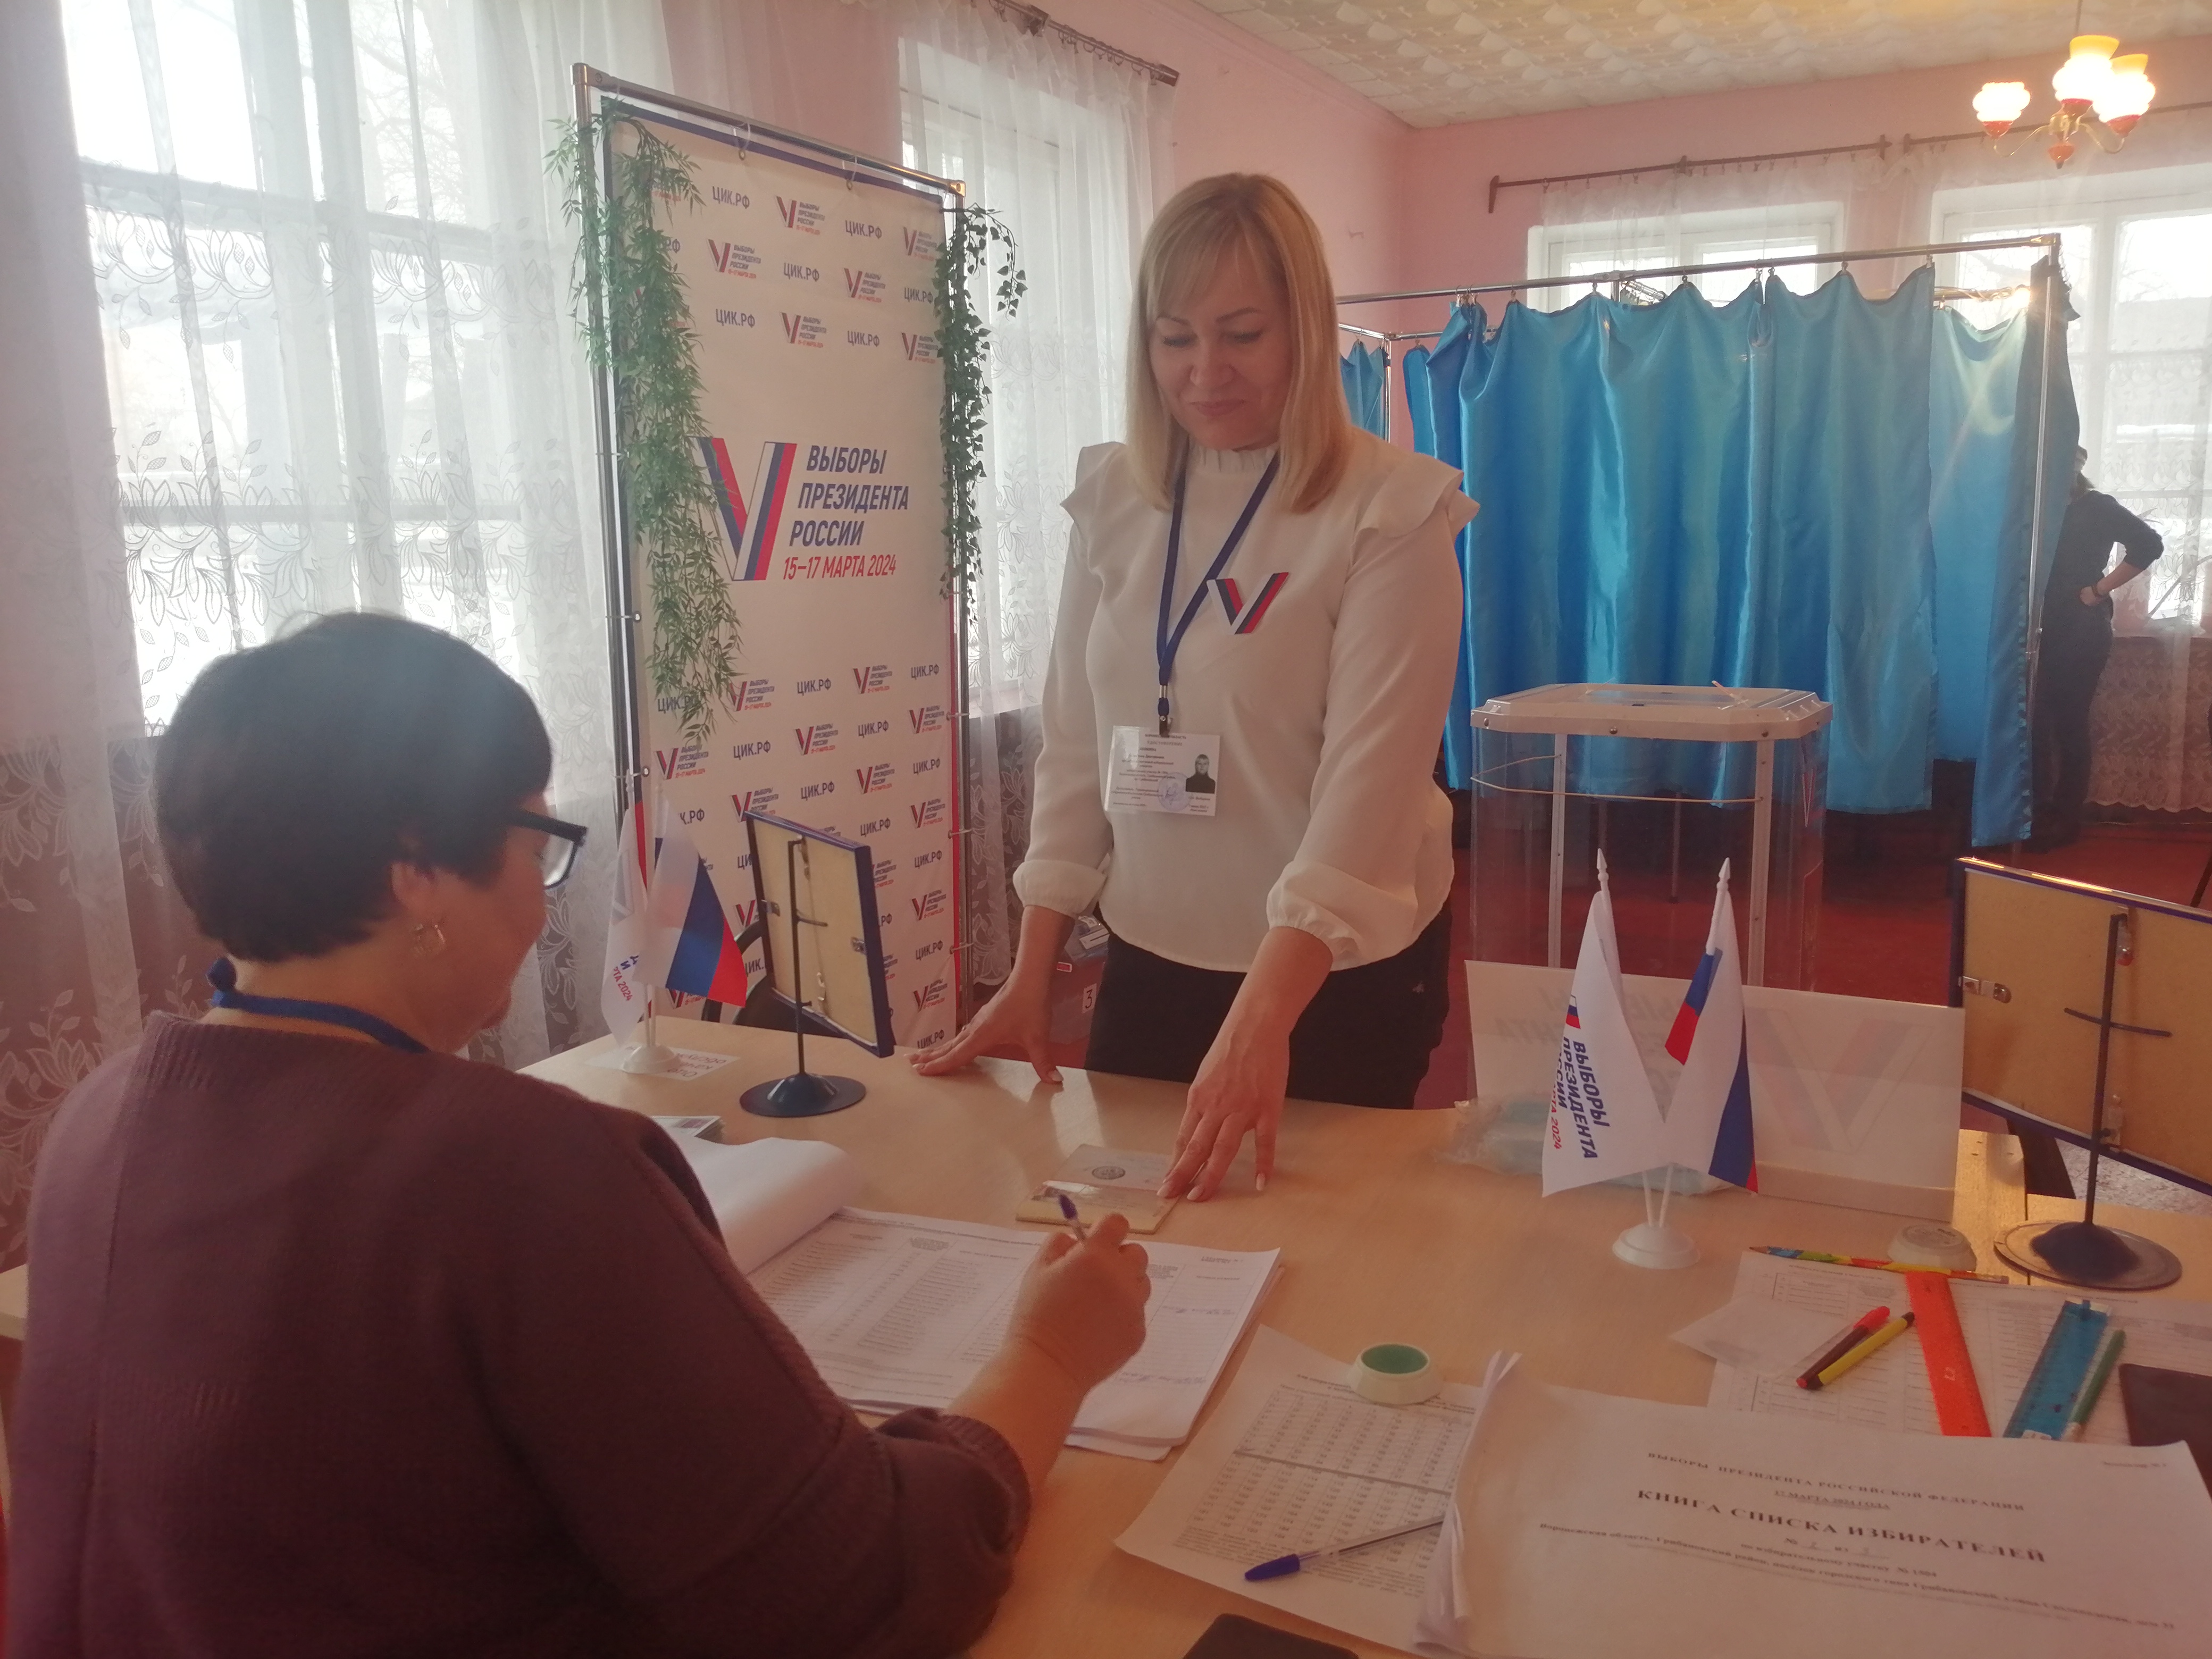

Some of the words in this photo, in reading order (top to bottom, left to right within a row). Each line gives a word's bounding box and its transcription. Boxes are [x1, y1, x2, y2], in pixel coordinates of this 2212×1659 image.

[712, 186, 750, 209] ЦИК.РФ
[845, 220, 882, 239] ЦИК.РФ
[783, 262, 819, 282] ЦИК.РФ
[904, 287, 934, 304] ЦИК.РФ
[716, 308, 756, 328] ЦИК.РФ
[847, 330, 880, 347] ЦИК.РФ
[806, 445, 887, 474] ВЫБОРЫ
[798, 482, 909, 514] ПРЕЗИДЕНТА
[789, 520, 865, 547] РОССИИ
[823, 555, 866, 579] МАРТА
[867, 554, 896, 577] 2024
[910, 664, 939, 680] ЦИК.РФ
[797, 678, 832, 696] ЦИК.РФ
[858, 720, 889, 738] ЦИК.РФ
[733, 740, 771, 760] ЦИК.РФ
[913, 757, 941, 775] ЦИК.РФ
[800, 781, 835, 801] ЦИК.РФ
[860, 817, 891, 837] ЦИК.РФ
[915, 850, 942, 869] ЦИК.РФ
[916, 940, 943, 960] ЦИК.РФ
[617, 981, 633, 1001] 2024
[1085, 988, 1093, 1009] 3
[1573, 1041, 1611, 1127] ВЫБОРЫ
[1563, 1036, 1598, 1158] ПРЕЗИДЕНТА
[1551, 1116, 1562, 1149] 2024
[1648, 1452, 1708, 1469] ВЫБОРЫ
[1719, 1466, 1812, 1486] ПРЕЗИДЕНТА
[1819, 1481, 1922, 1498] РОССИЙСКОЙ
[1928, 1494, 2024, 1511] ФЕДЕРАЦИИ
[1789, 1492, 1829, 1503] МАРТА
[1637, 1490, 1721, 1514] КНИГА
[1730, 1507, 1837, 1534] СПИСКА
[1848, 1526, 2045, 1563] ИЗБИРАТЕЛЕЙ
